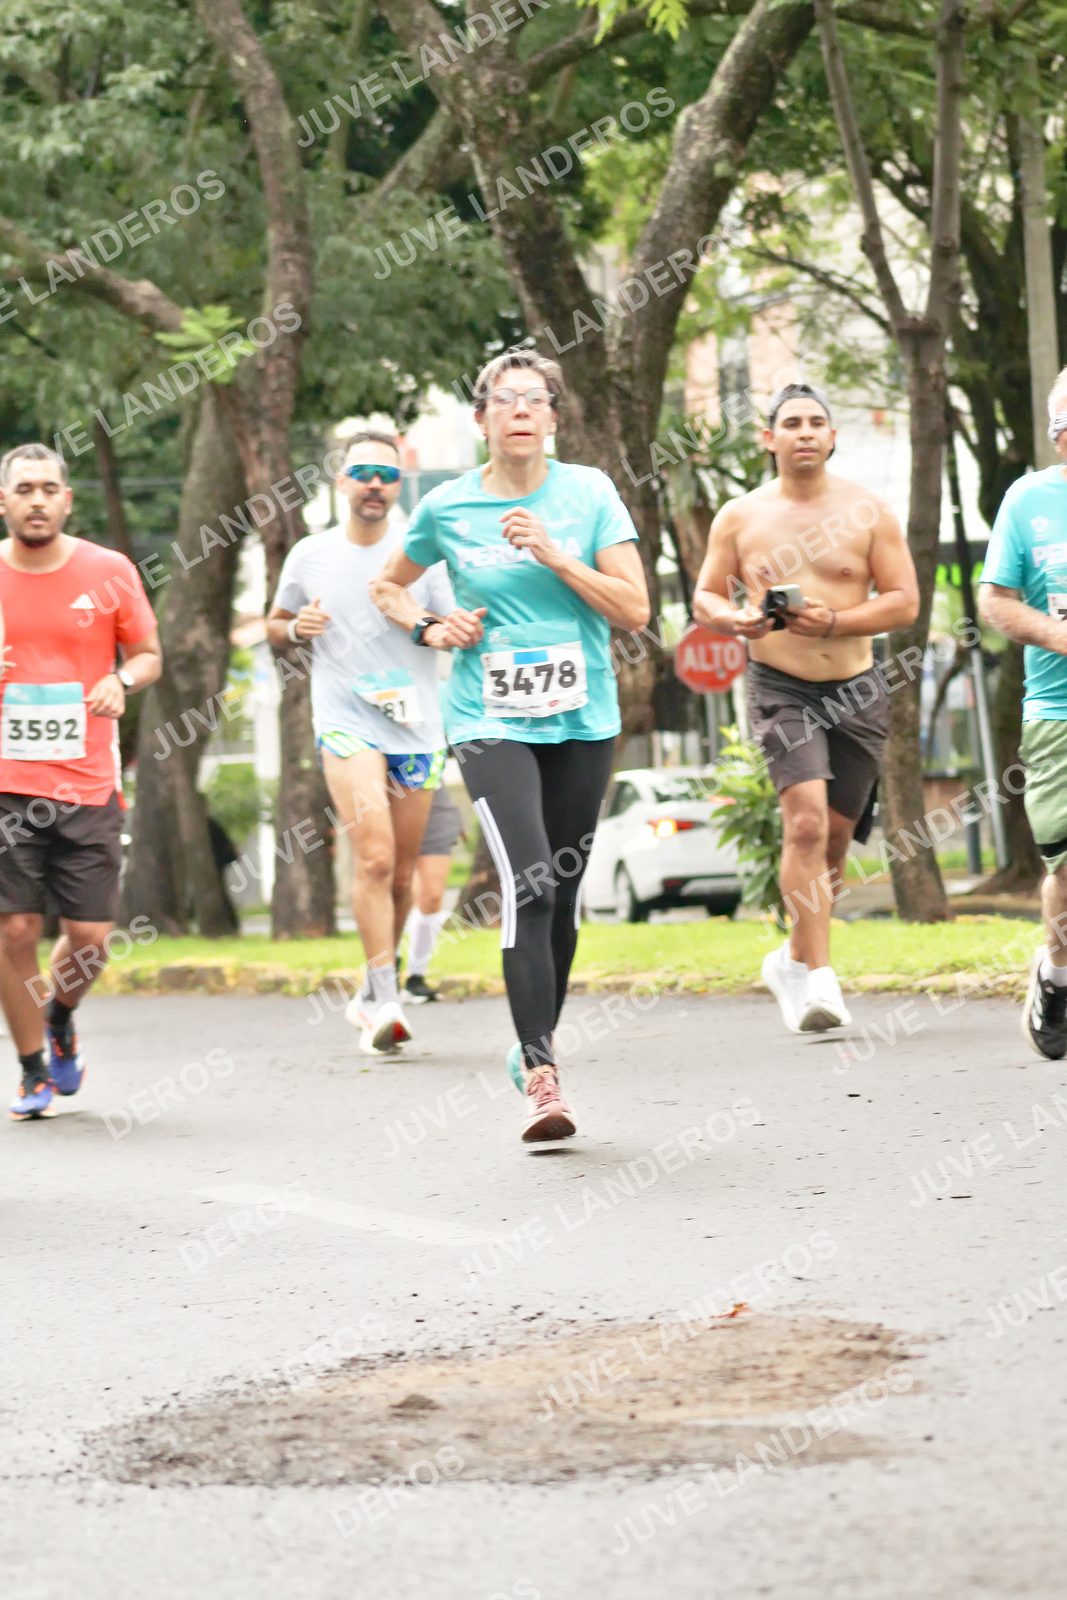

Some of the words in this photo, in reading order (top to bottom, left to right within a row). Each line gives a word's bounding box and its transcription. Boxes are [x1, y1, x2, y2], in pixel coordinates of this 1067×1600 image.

[683, 640, 742, 672] ALTO
[489, 660, 577, 697] 3478
[8, 718, 79, 741] 3592
